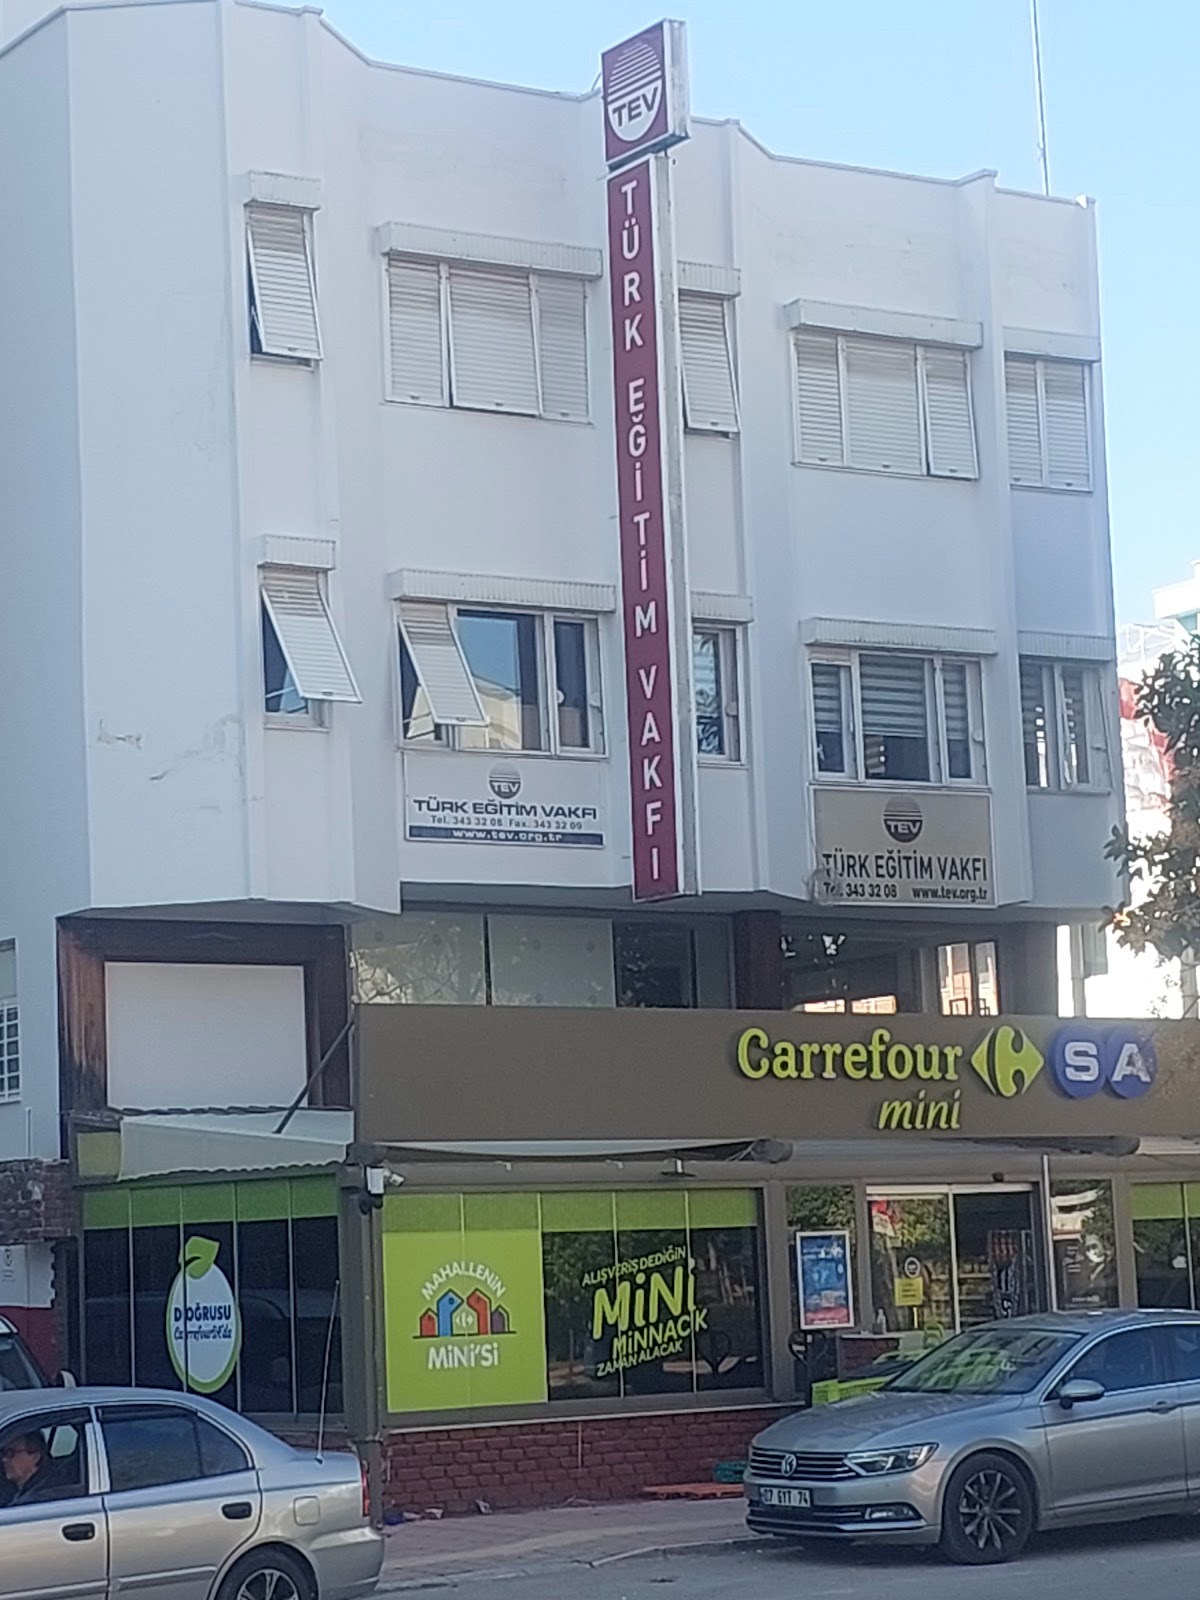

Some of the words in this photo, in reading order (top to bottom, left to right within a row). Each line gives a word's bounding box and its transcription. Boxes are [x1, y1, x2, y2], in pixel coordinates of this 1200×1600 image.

[612, 87, 659, 127] TEV
[621, 180, 643, 351] TÜRK
[628, 378, 658, 638] EĞİTİM
[491, 782, 520, 793] TEV
[638, 665, 662, 881] VAKFI
[413, 796, 469, 814] TÜRK
[472, 798, 538, 818] EĞİTİM
[541, 805, 597, 820] VAKFI
[453, 816, 472, 826] 343
[475, 817, 487, 826] 32
[532, 820, 552, 829] 343
[555, 821, 567, 830] 32
[452, 829, 563, 842] www.tev.org.tr
[886, 821, 921, 834] TEV
[822, 848, 871, 878] TÜRK
[875, 849, 933, 880] EĞİTİM
[937, 856, 988, 881] VAKFI
[823, 881, 844, 897] Te.
[845, 882, 866, 897] 343
[868, 883, 882, 898] 32
[884, 883, 897, 898] 08
[912, 885, 987, 903] www.tev.org.tr
[737, 1027, 963, 1080] Carrefour
[878, 1089, 962, 1131] mini
[174, 1302, 232, 1322] DOĞRUSU
[597, 1352, 638, 1377] ZAMAN
[638, 1338, 683, 1363] ALACAK
